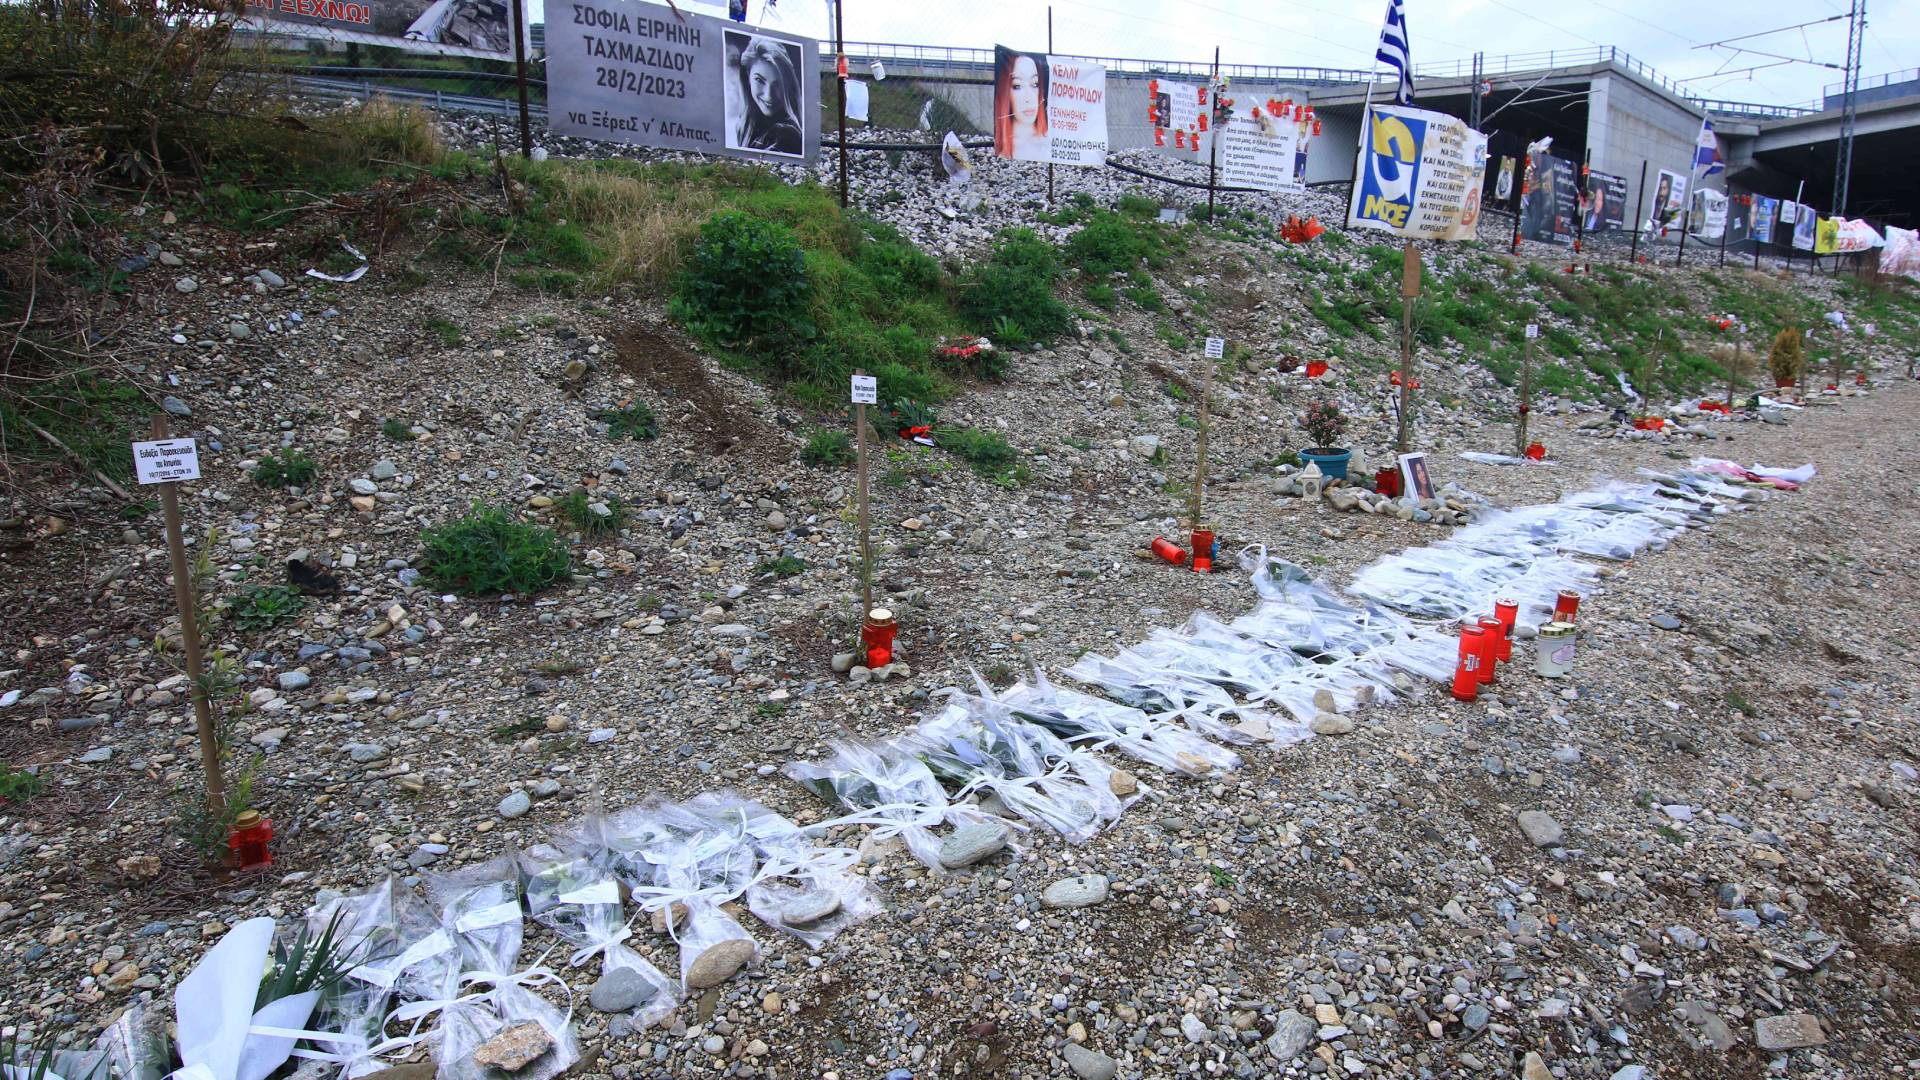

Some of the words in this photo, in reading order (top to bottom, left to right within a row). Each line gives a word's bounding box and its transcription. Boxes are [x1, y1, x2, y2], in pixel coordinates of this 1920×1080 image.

[280, 0, 370, 24] ΞΕΧΝΩ!
[573, 4, 631, 34] ΣΟΦΙΑ
[638, 16, 700, 47] ΕΙΡΗΝΗ
[583, 36, 694, 73] ΤΑΧΜΑΖΙΔΟΥ
[597, 67, 685, 98] 28/2/2023
[1051, 82, 1102, 104] ΠΟΡΦΥΡΙΔΟΥ
[568, 111, 587, 125] να
[1050, 107, 1087, 121] ΓΕΝΝΗΘΗΚΕ
[1051, 138, 1105, 151] ΔΟΛΟΦΟΝΗΘΗΚΕ
[1441, 148, 1449, 156] ΝΑ
[1423, 157, 1435, 165] ΚΑΙ
[1433, 170, 1447, 178] ΤΟΥΣ
[1427, 180, 1438, 188] ΚΑΙ
[1423, 213, 1433, 221] ΚΑΙ
